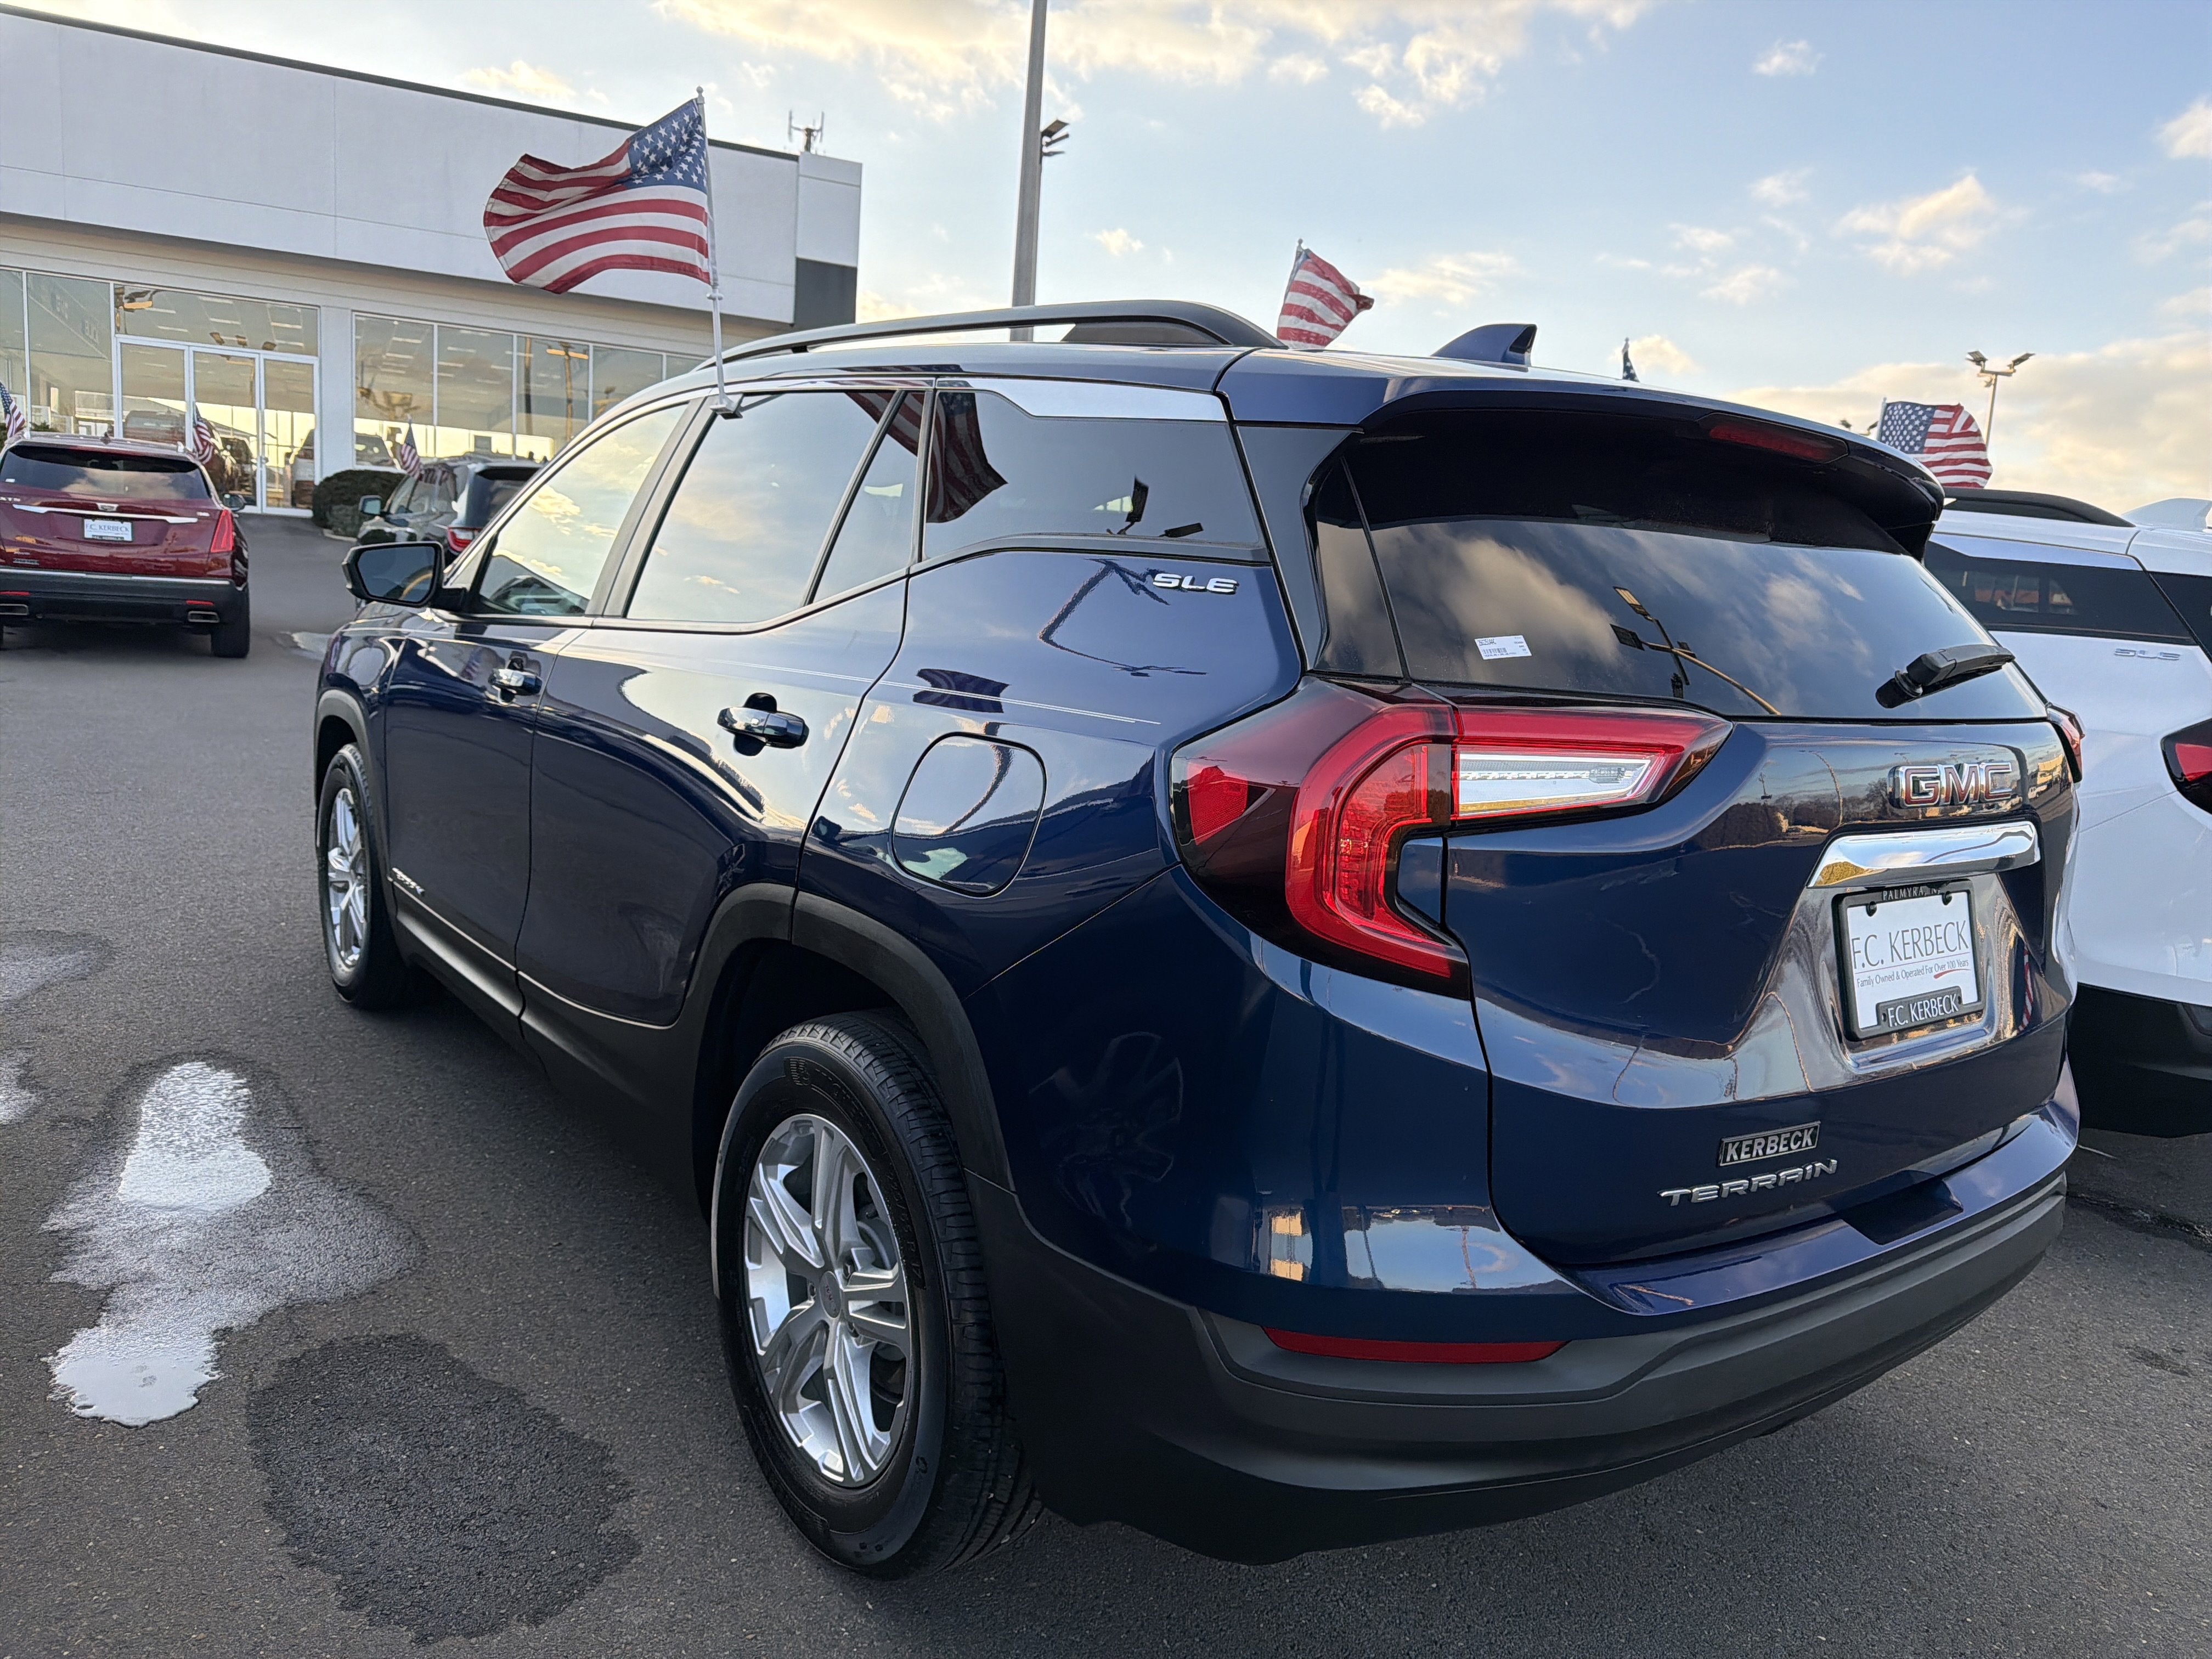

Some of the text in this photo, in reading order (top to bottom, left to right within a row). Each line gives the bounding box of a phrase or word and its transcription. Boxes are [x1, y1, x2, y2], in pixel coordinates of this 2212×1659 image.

[1153, 573, 1239, 595] SLE
[2114, 648, 2181, 661] SLE
[1891, 761, 2013, 808] GMC
[1852, 920, 1969, 969] F.C. KERBECK
[1857, 976, 1874, 988] Family
[1875, 972, 1894, 984] Owned
[1896, 972, 1900, 980] &
[1901, 966, 1925, 980] Operated
[1934, 963, 1946, 972] Over
[1947, 961, 1956, 969] 100
[1957, 959, 1969, 968] Years
[1888, 994, 1959, 1027] F.C. KERBECK
[1726, 1128, 1815, 1163] KERBECK
[1657, 1159, 1838, 1206] TERRAIN
